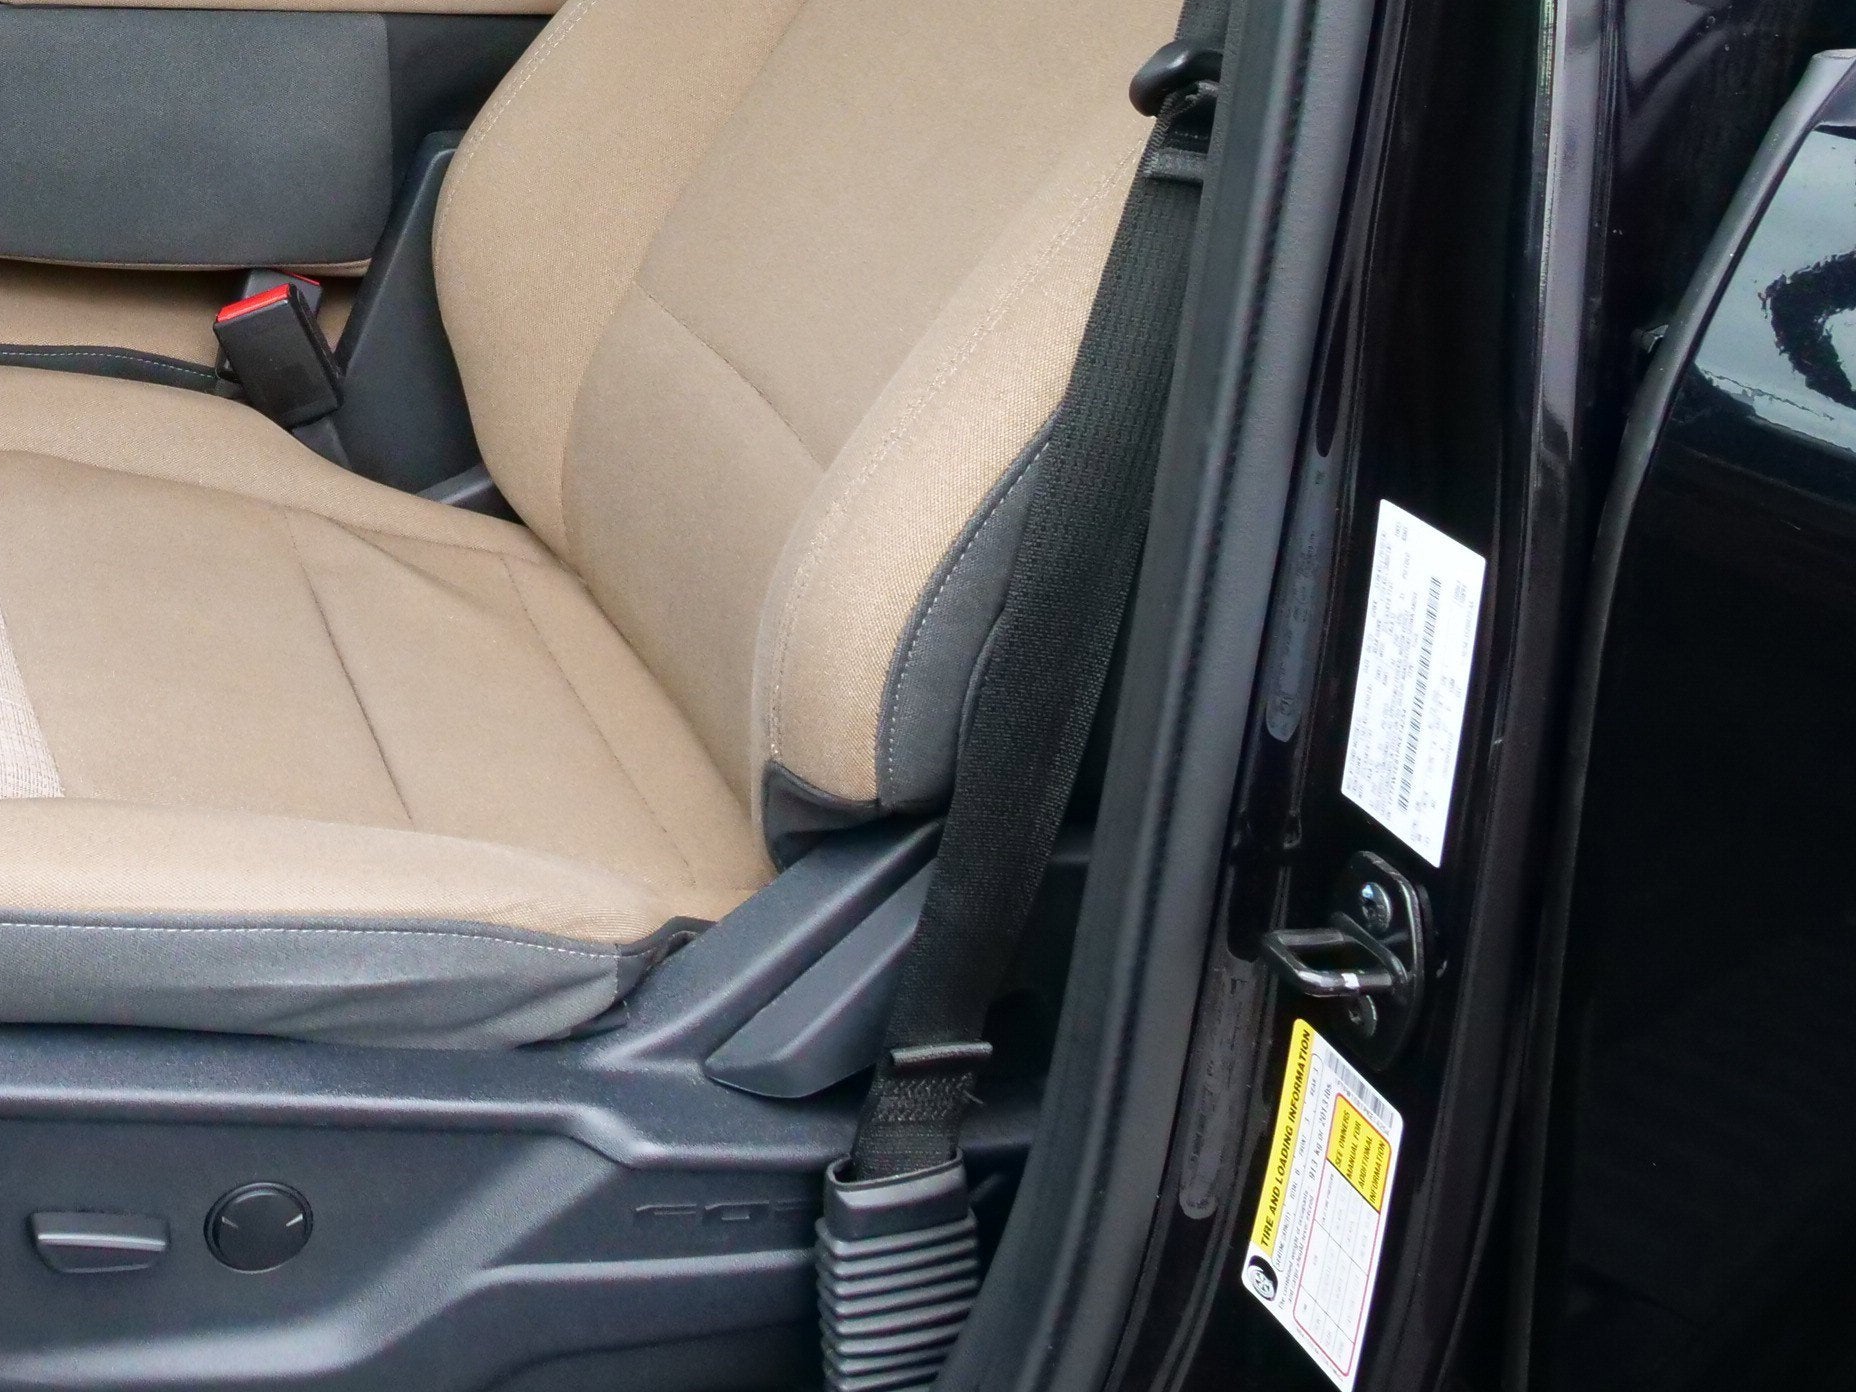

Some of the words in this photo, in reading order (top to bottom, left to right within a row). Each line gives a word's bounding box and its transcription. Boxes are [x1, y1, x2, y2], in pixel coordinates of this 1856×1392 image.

[1261, 1215, 1274, 1247] TIRE
[1269, 1186, 1280, 1216] AND
[1275, 1125, 1293, 1184] LOADING
[1287, 1029, 1311, 1125] INFORMATION
[1313, 1141, 1324, 1157] kg
[1338, 1110, 1350, 1149] OWNERS
[1346, 1142, 1358, 1179] MANUAL
[1353, 1120, 1361, 1141] FOR
[1335, 1149, 1343, 1167] SEE
[1358, 1136, 1373, 1189] ADDITIONAL
[1369, 1140, 1385, 1204] INFORMATION
